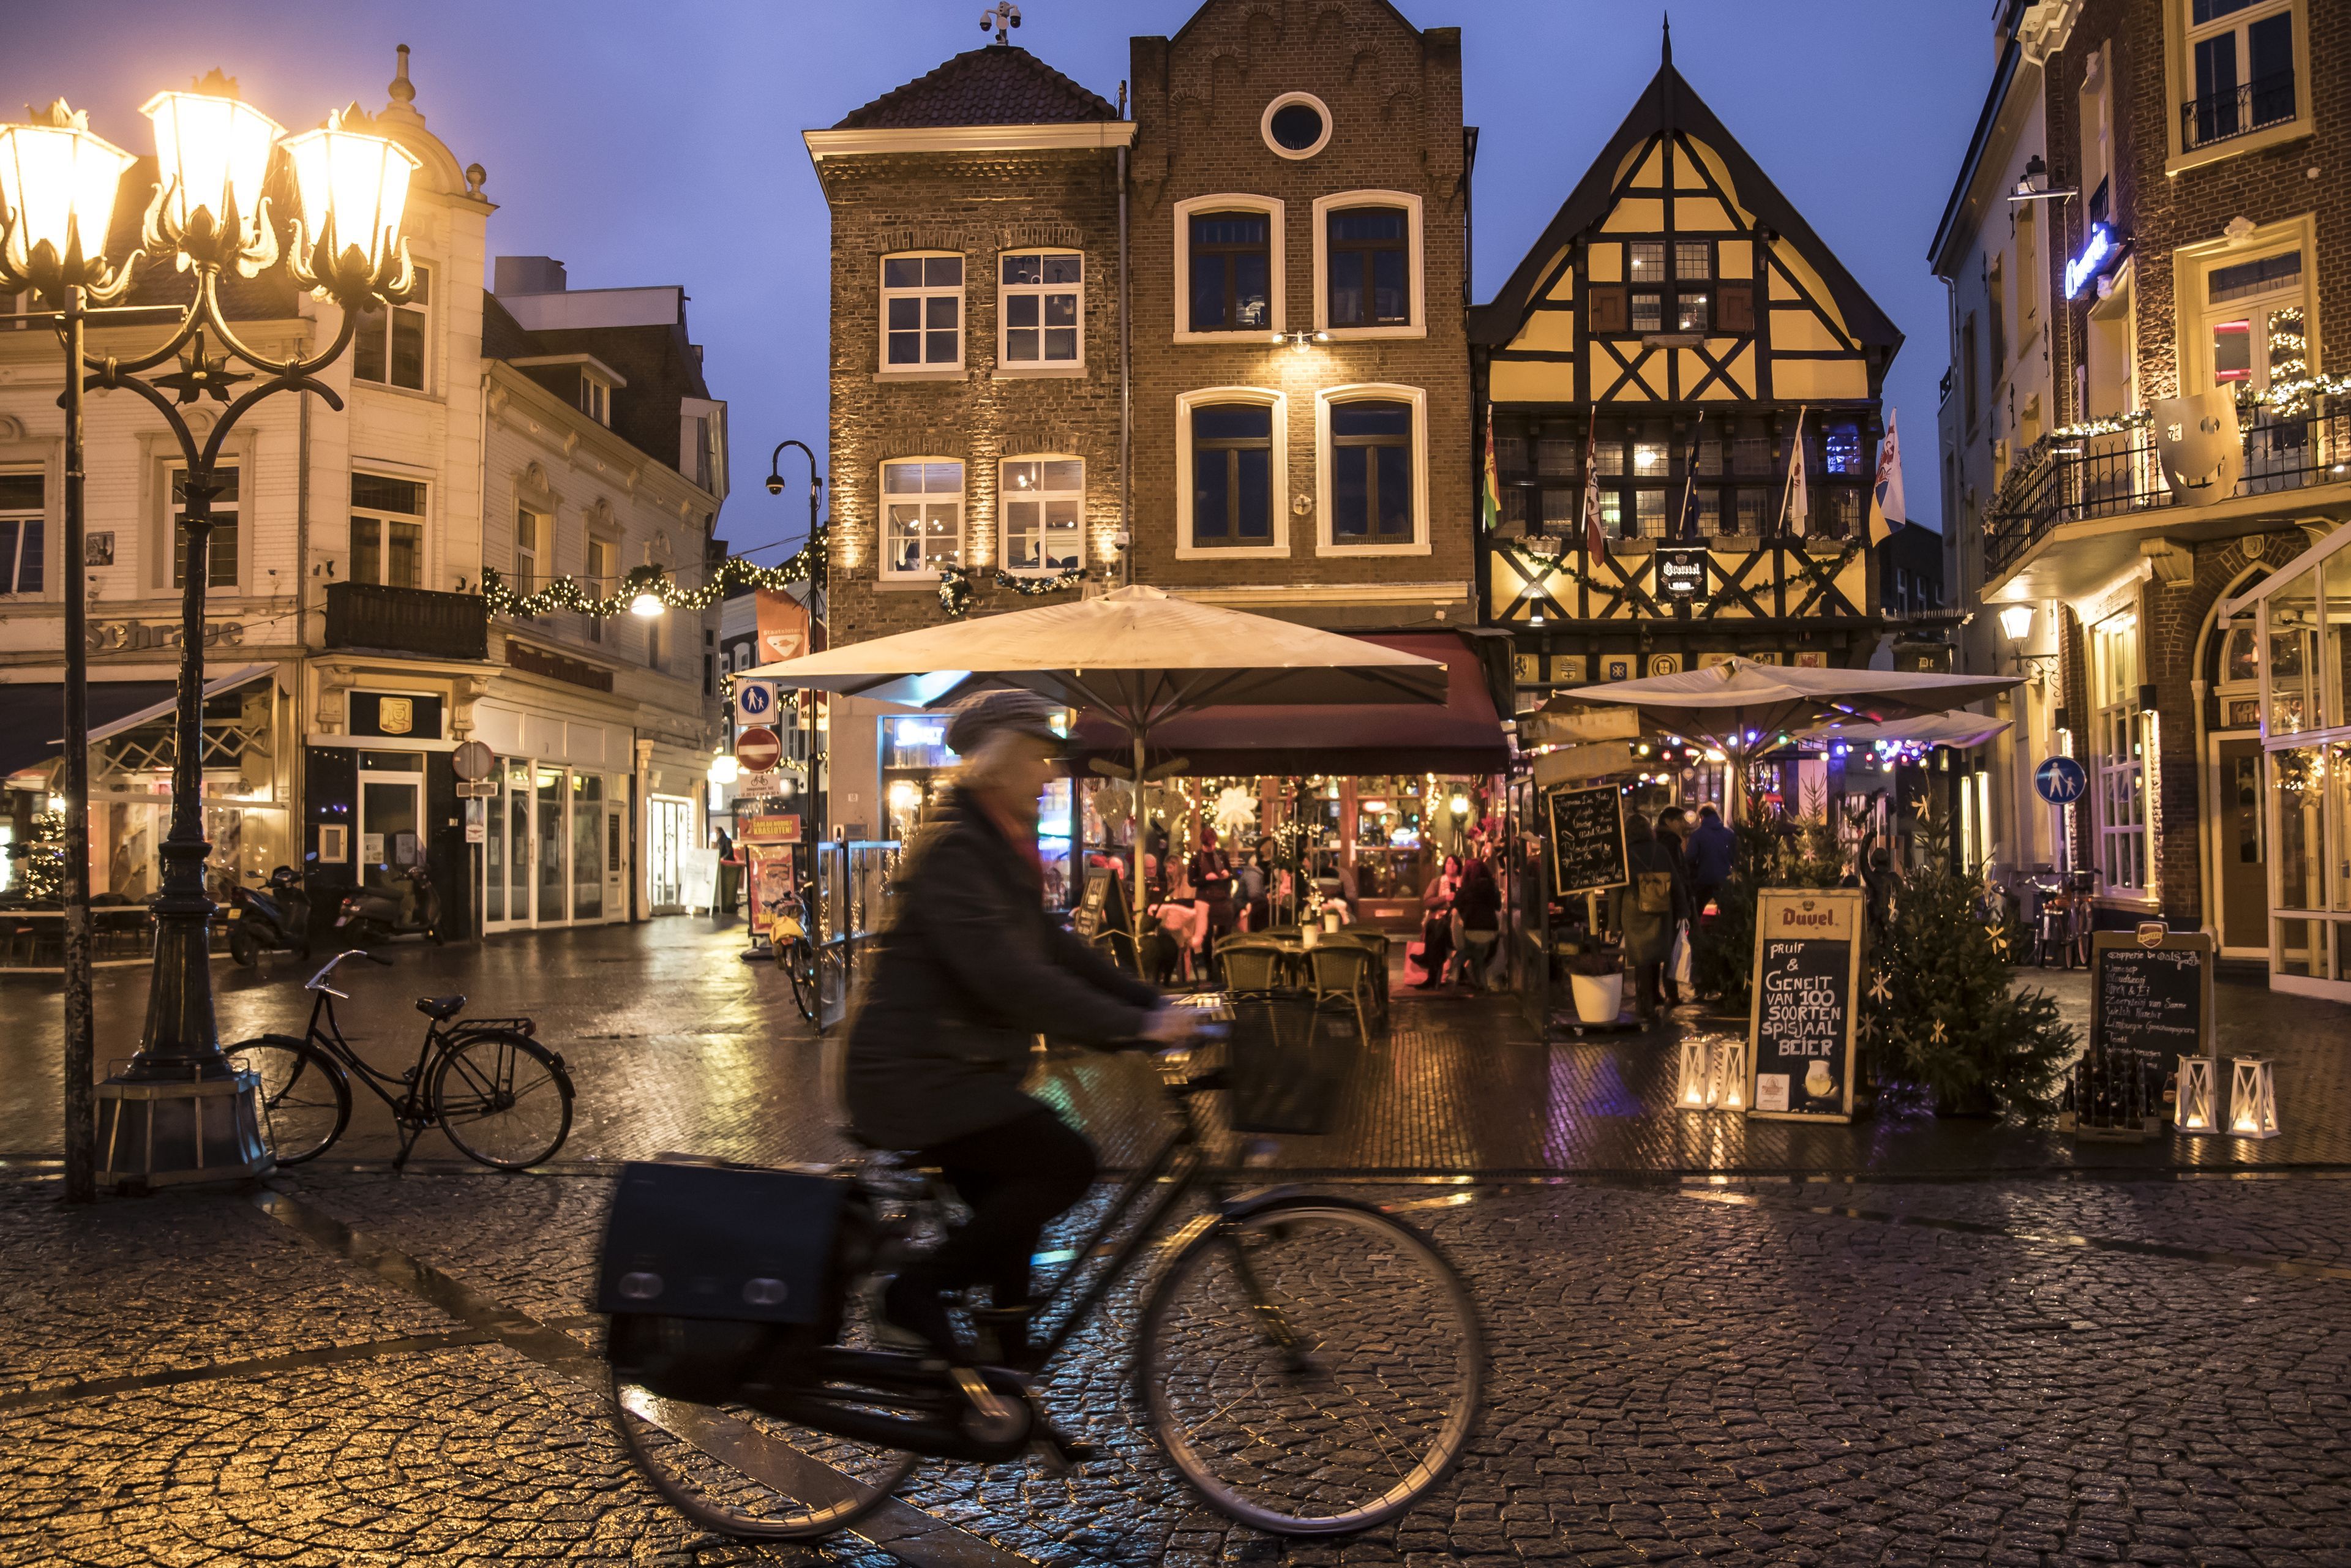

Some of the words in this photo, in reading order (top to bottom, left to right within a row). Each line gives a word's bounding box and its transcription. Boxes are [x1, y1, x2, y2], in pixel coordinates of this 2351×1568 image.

[1782, 907, 1833, 926] Duvel
[1787, 958, 1799, 972] &
[1767, 992, 1793, 1006] VAN
[1800, 991, 1834, 1006] 100
[1768, 1007, 1840, 1021] SOORTEN
